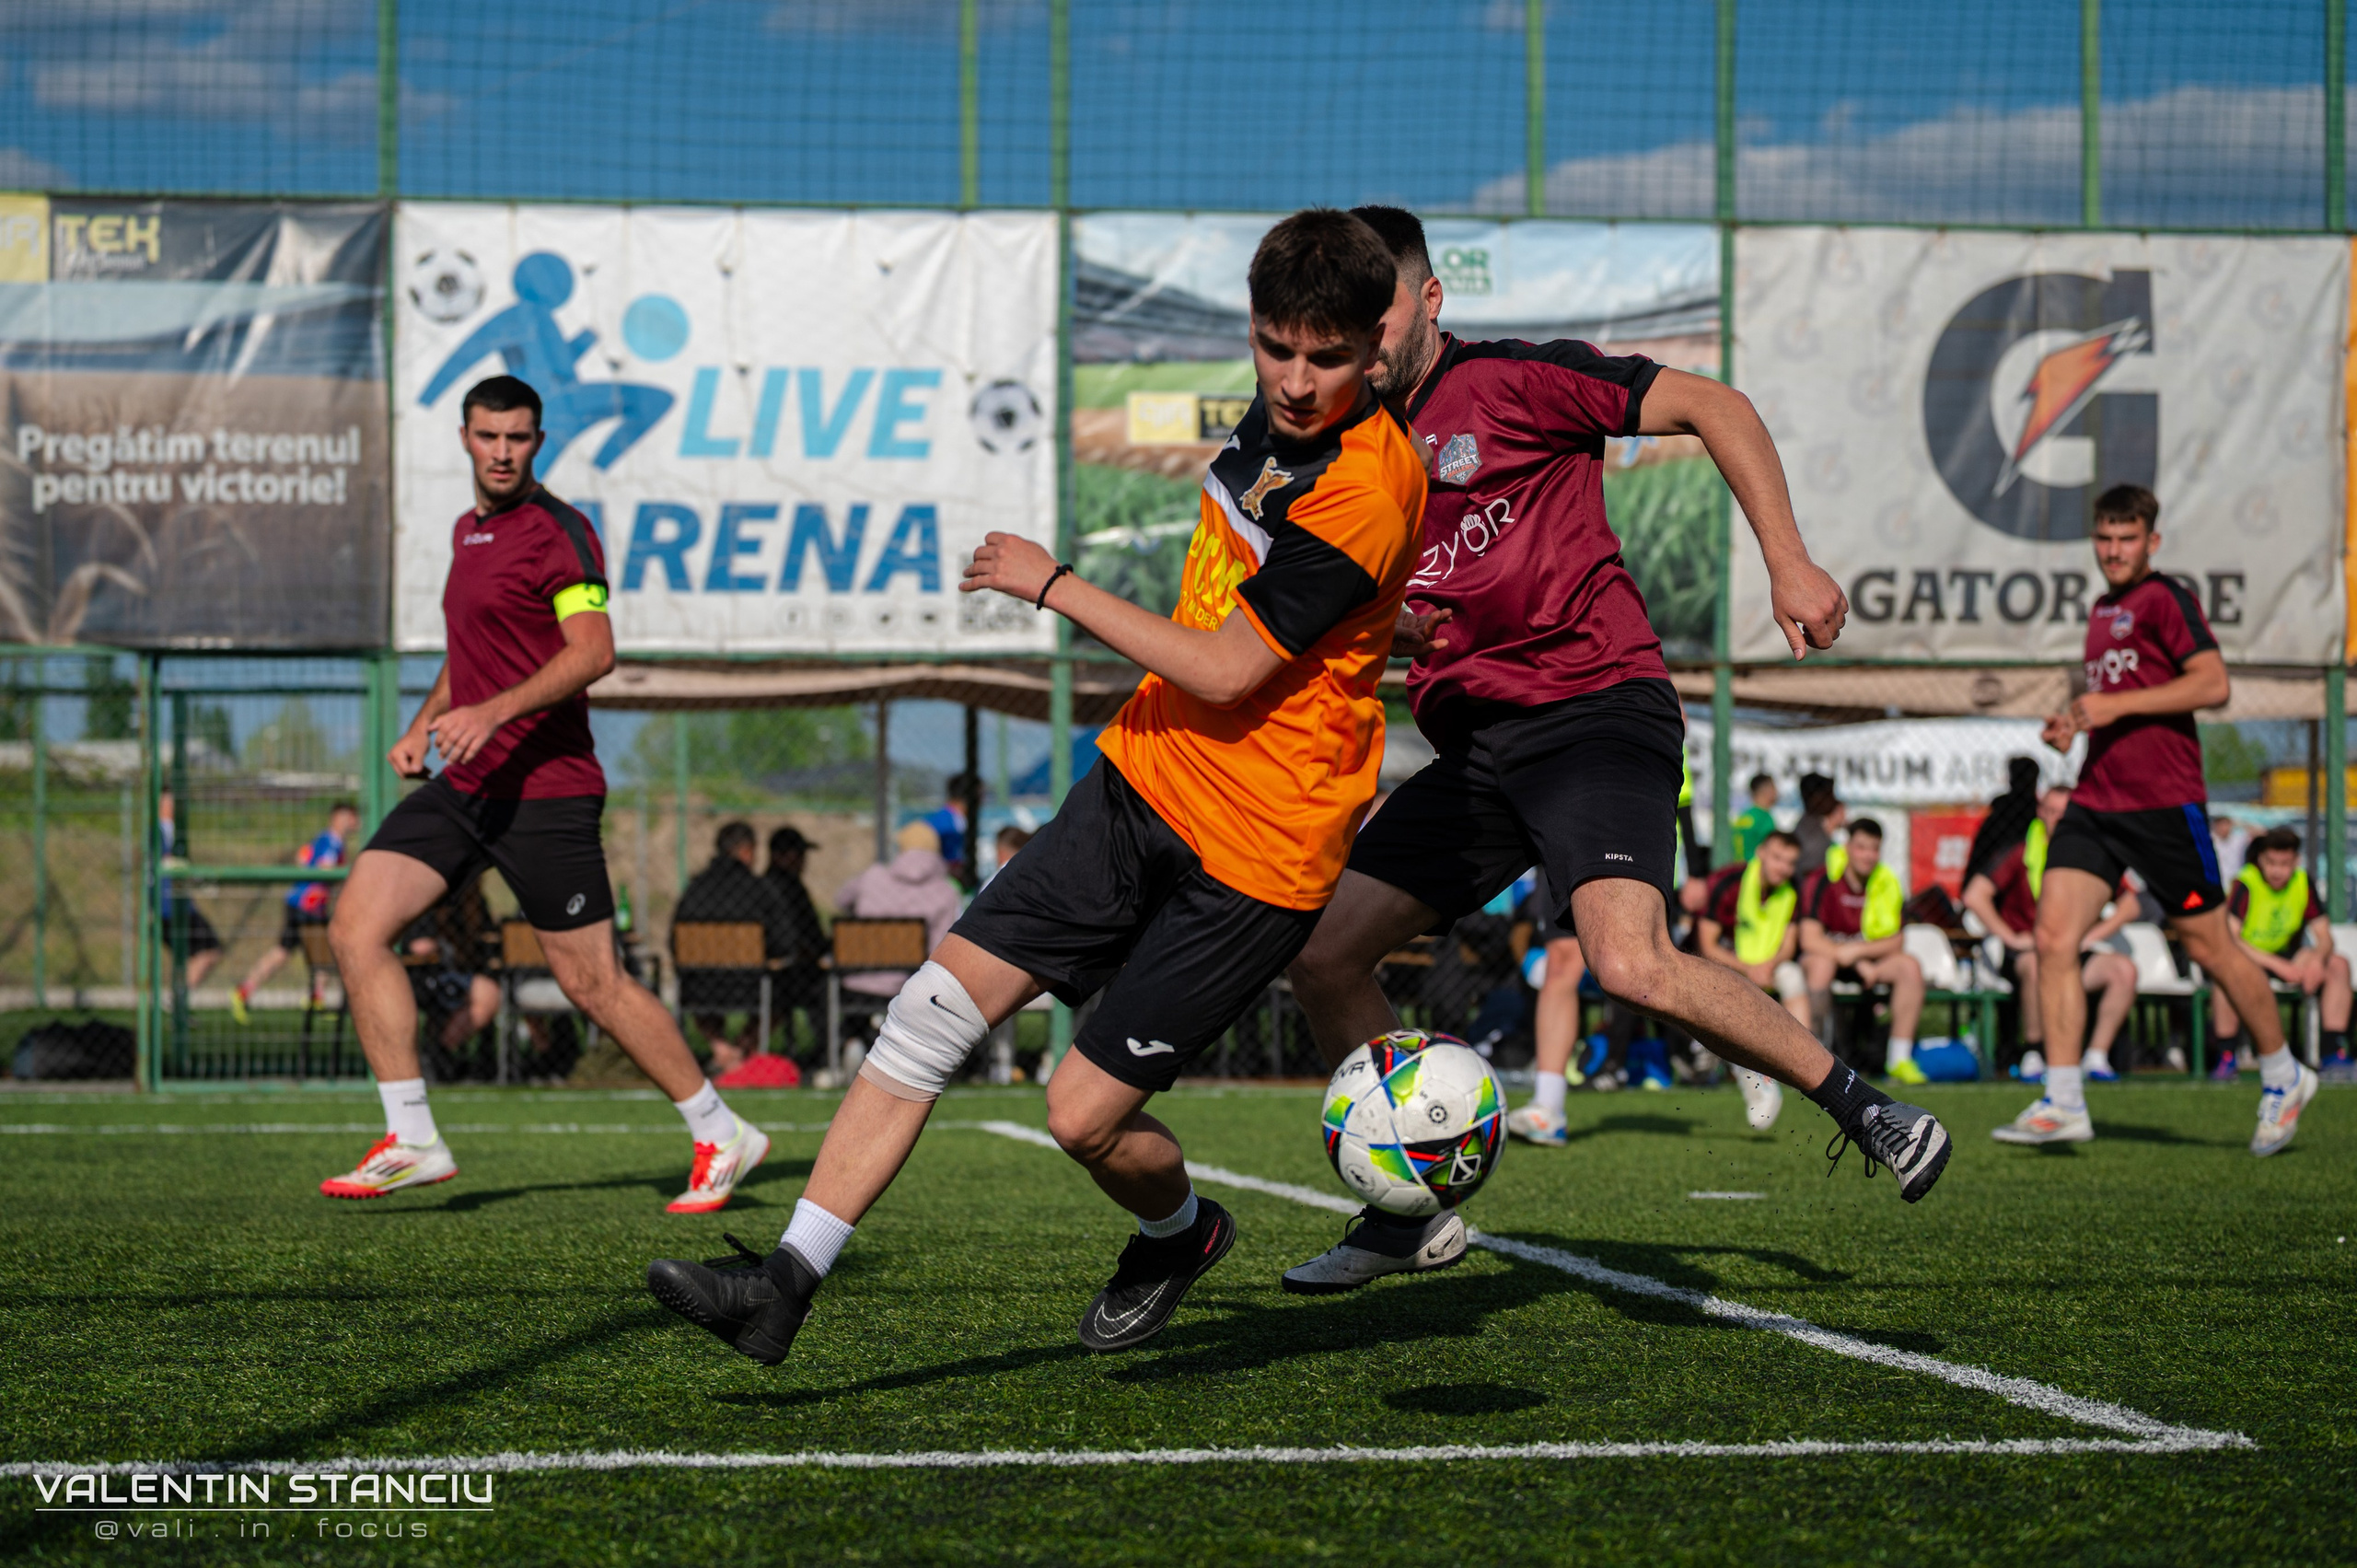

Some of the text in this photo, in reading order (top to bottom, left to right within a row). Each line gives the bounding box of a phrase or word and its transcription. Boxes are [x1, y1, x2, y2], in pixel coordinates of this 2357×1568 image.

[678, 367, 942, 459] LIVE
[17, 424, 361, 472] Pregătim terenul
[1440, 454, 1479, 480] STREET
[32, 466, 347, 514] pentru victorie!
[1850, 568, 2245, 624] GATORE
[1605, 853, 1634, 863] KIPSTA
